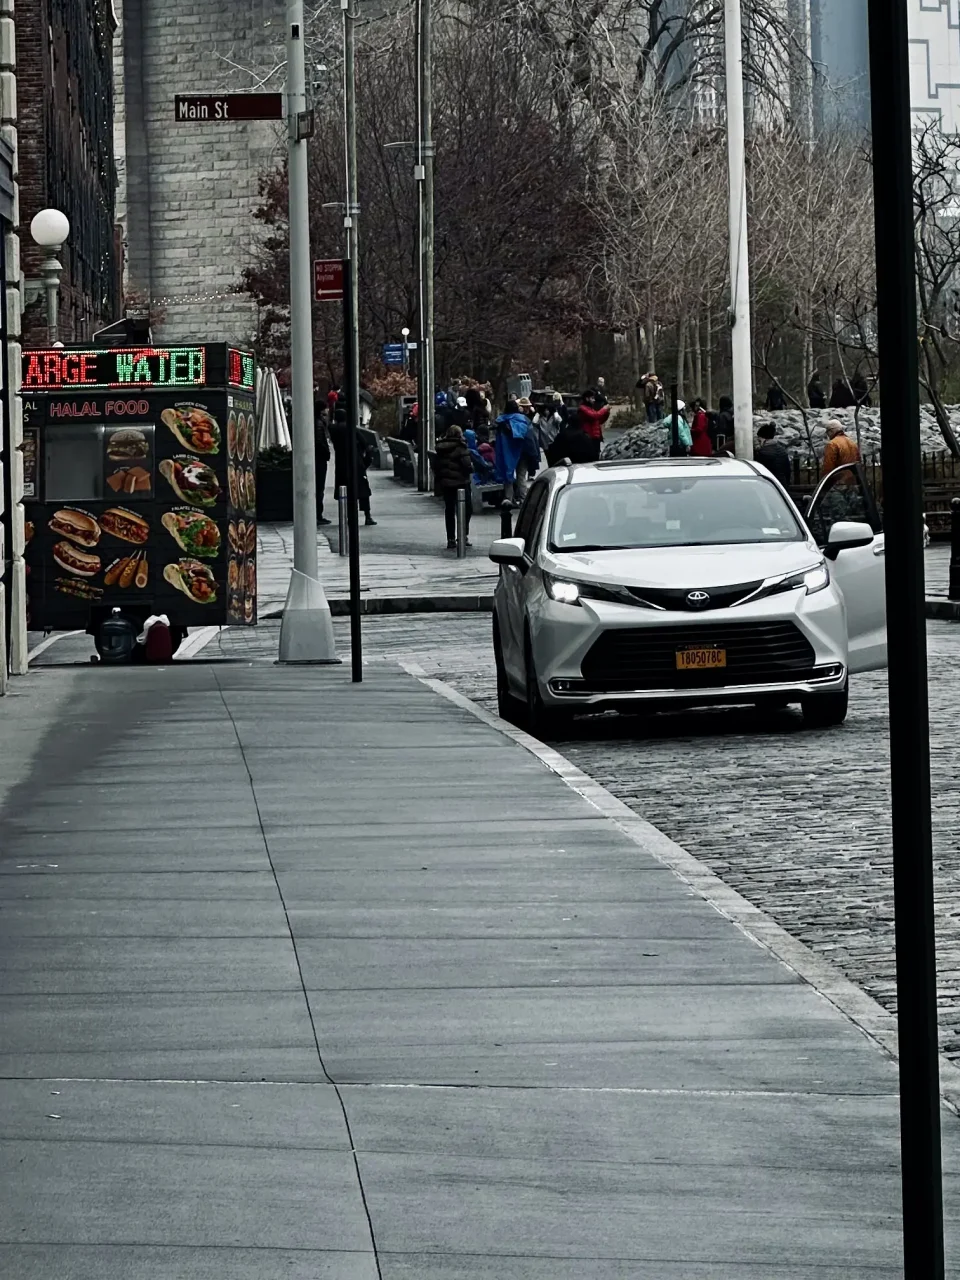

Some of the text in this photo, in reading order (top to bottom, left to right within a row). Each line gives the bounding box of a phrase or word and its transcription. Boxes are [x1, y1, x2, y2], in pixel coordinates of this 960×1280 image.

[179, 101, 229, 118] Main St
[324, 262, 342, 272] STOPPIN
[21, 354, 97, 384] ARGE
[50, 400, 149, 417] HALAL FOOD
[680, 651, 721, 665] T805078C
